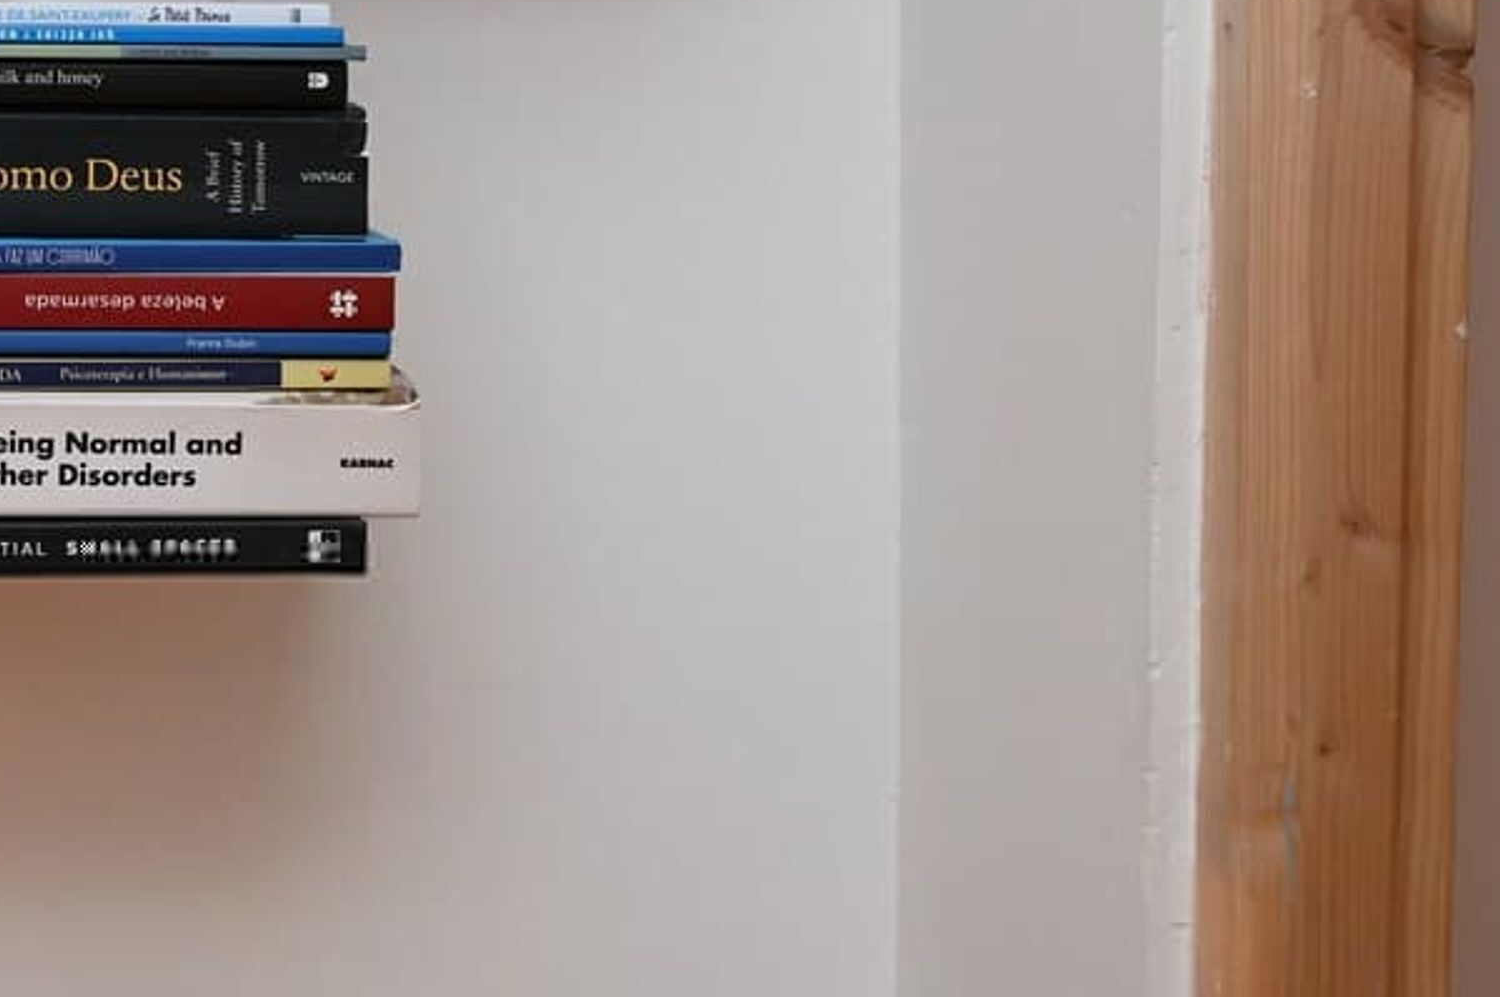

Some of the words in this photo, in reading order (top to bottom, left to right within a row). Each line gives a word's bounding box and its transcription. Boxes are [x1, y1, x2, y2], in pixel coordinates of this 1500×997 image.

[24, 69, 54, 84] and
[57, 69, 103, 90] honey
[85, 158, 183, 192] Deus
[300, 171, 355, 184] VINTAGE
[25, 294, 135, 311] desarmada
[141, 294, 206, 309] beleza
[65, 430, 176, 456] Normal
[186, 431, 243, 456] and
[58, 463, 197, 487] Disorders
